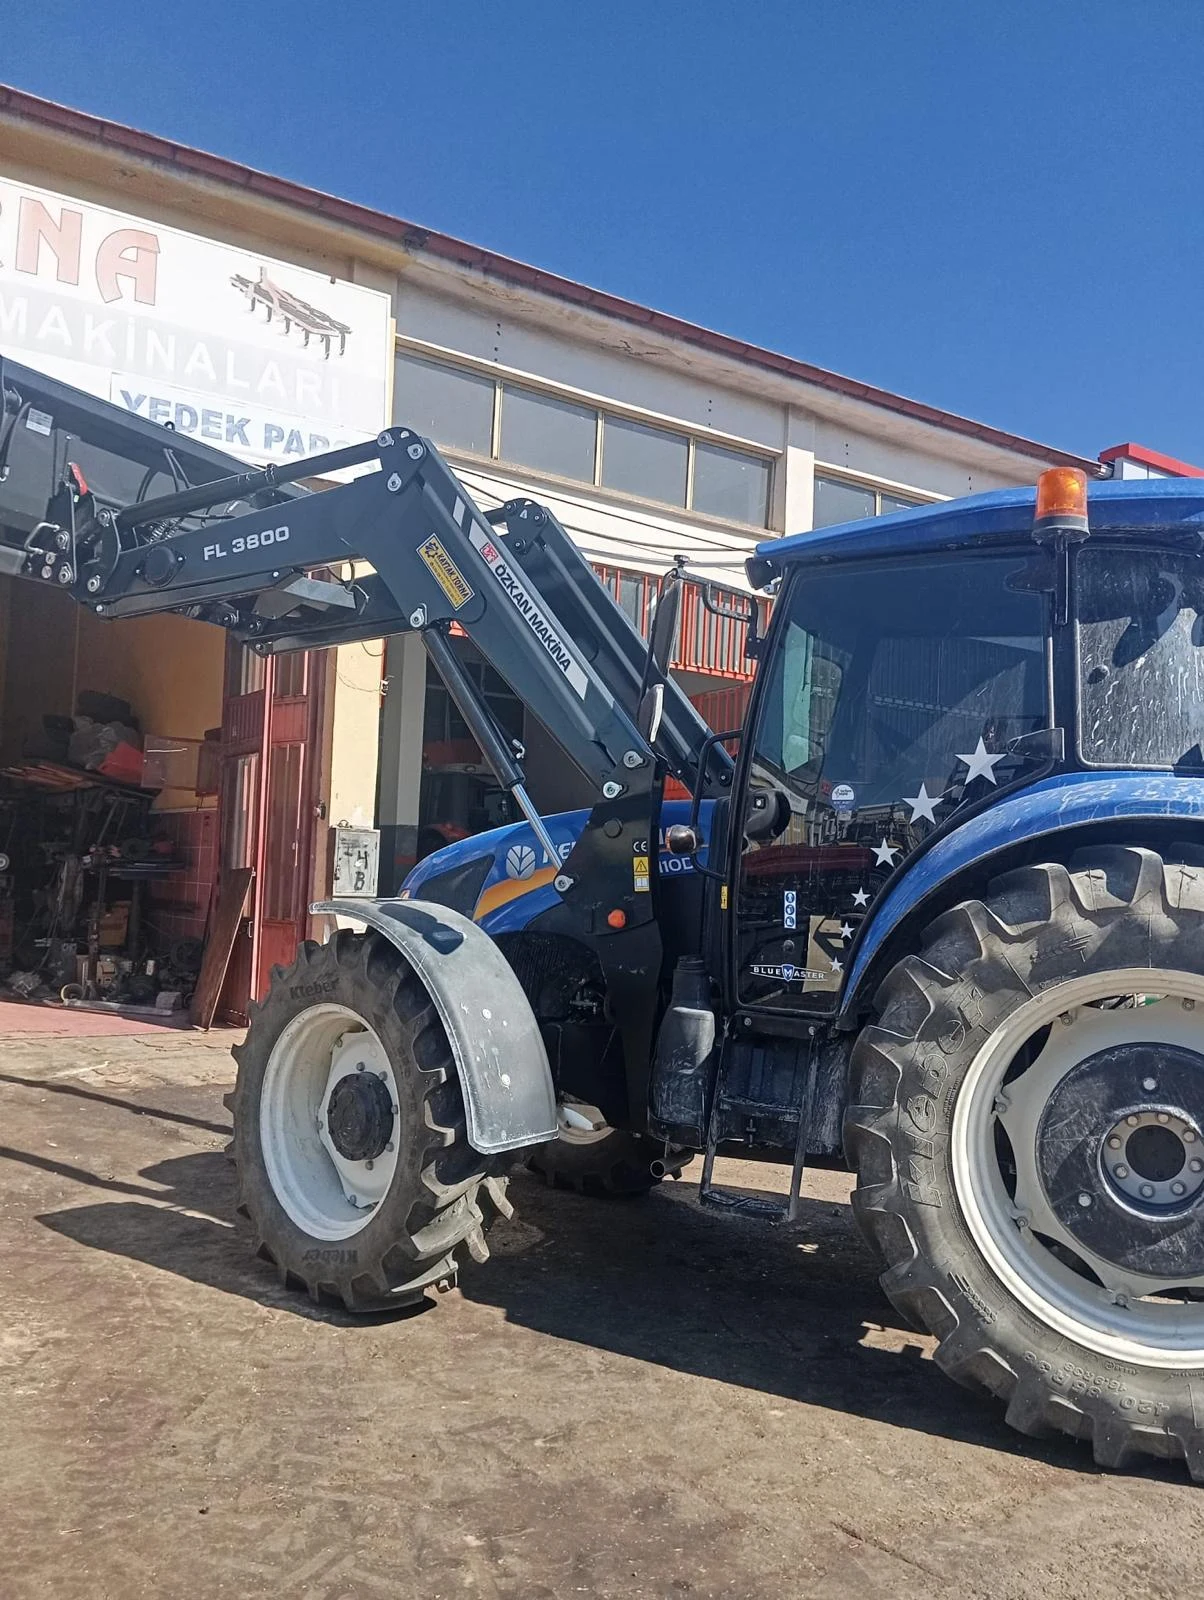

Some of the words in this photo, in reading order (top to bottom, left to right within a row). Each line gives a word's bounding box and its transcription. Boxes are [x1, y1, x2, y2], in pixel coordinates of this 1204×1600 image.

[0, 188, 161, 306] NA
[120, 389, 251, 447] YEDEK
[204, 542, 226, 561] FL
[232, 526, 289, 552] 3800
[495, 564, 532, 615] ÖZKAN
[529, 612, 571, 672] MAKİNA
